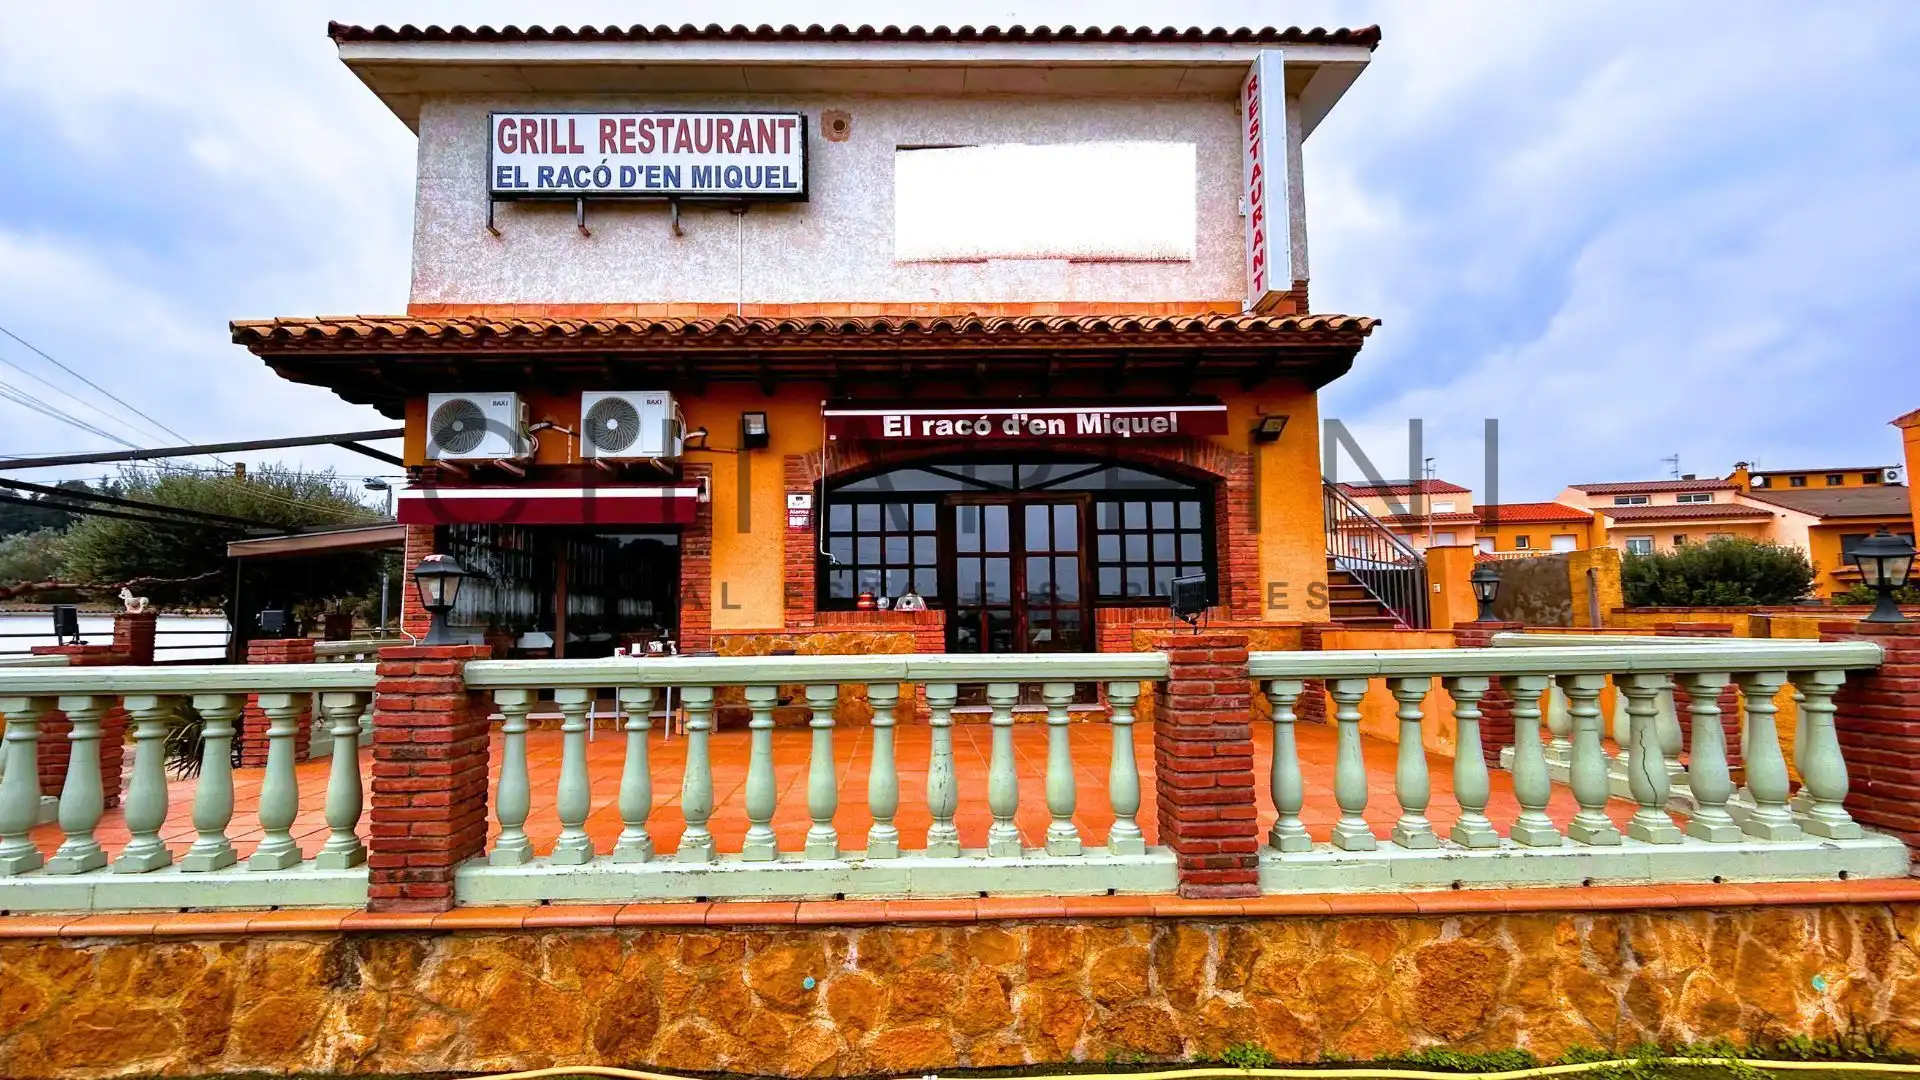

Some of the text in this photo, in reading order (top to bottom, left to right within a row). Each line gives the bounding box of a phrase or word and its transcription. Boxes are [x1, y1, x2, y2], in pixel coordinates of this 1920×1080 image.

[499, 118, 797, 154] GRILL RESTAURANT
[496, 159, 798, 189] EL RACÓ D'EN MIQUEL
[1247, 74, 1264, 292] RESTAURANT
[883, 411, 1178, 438] El racó d'en Miquel
